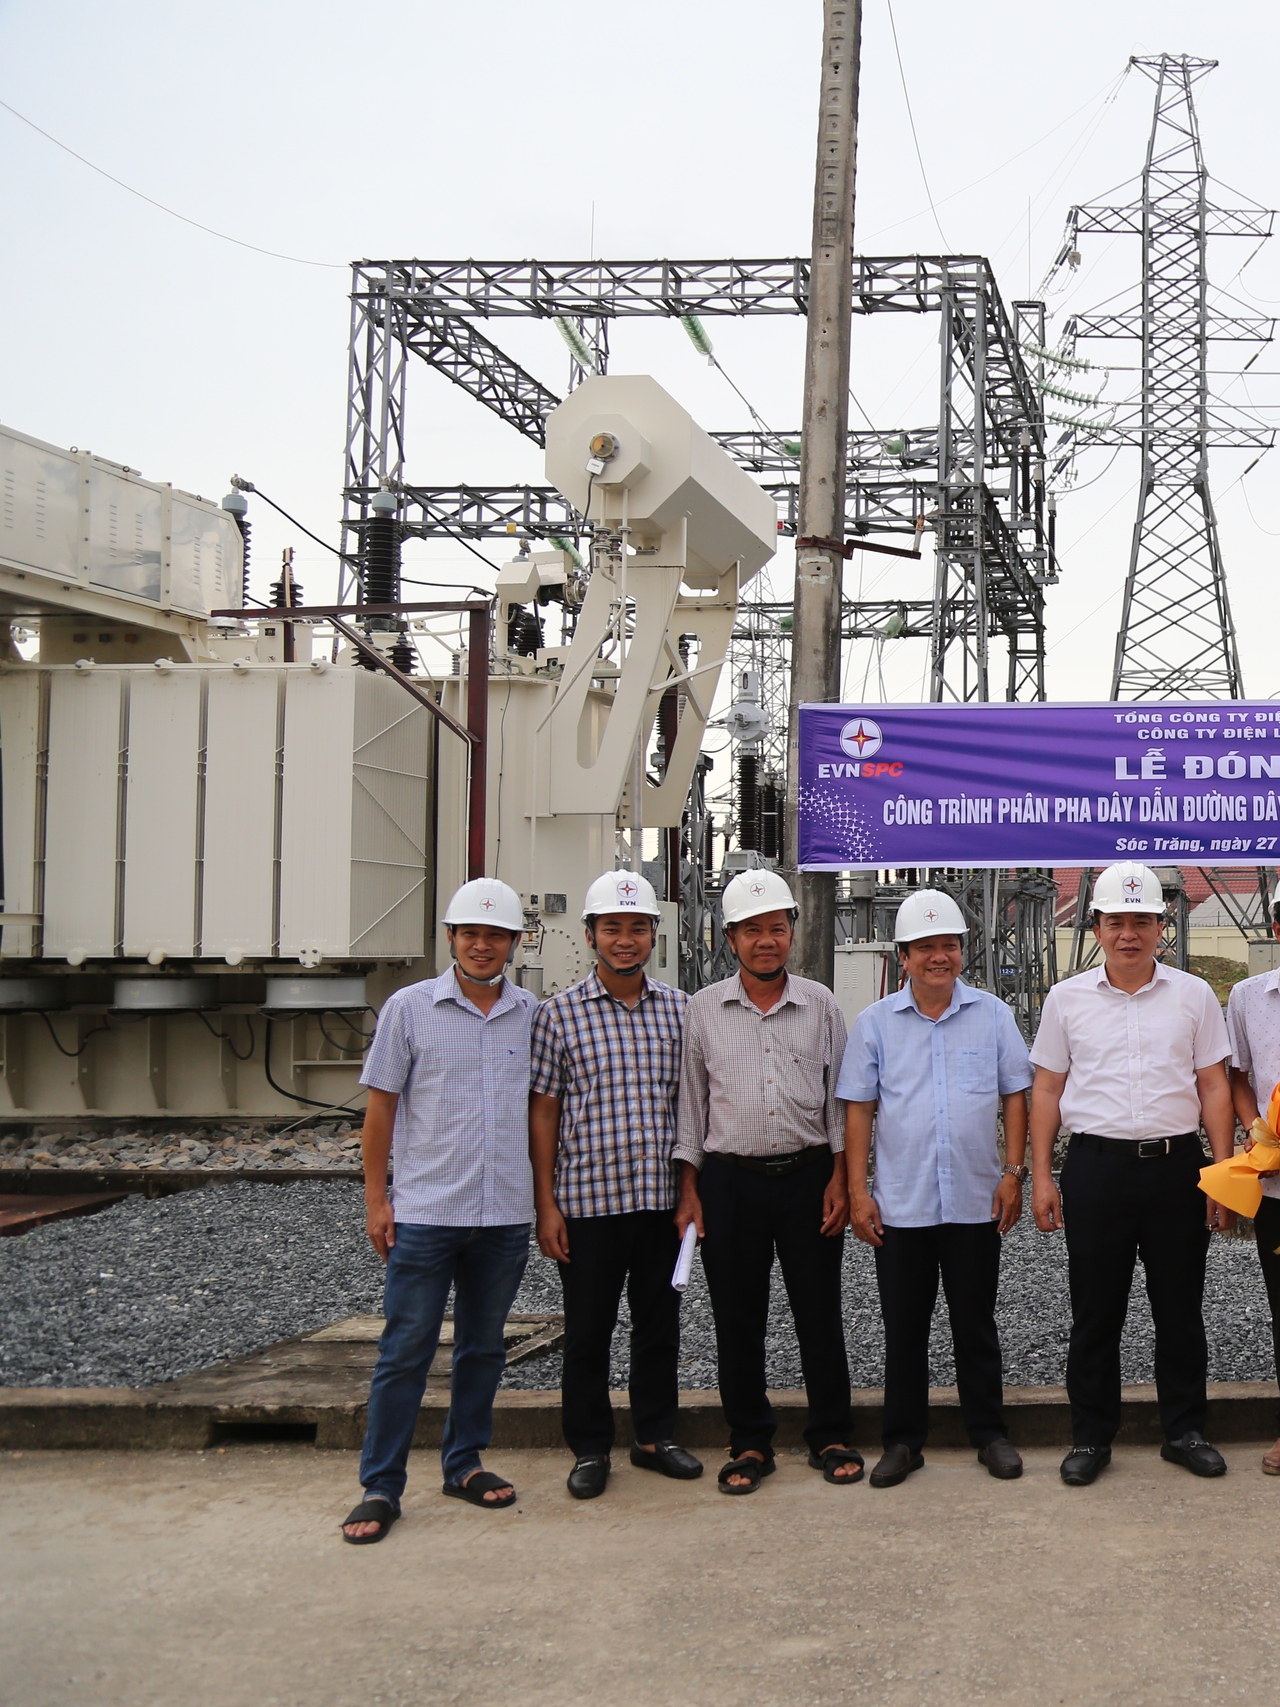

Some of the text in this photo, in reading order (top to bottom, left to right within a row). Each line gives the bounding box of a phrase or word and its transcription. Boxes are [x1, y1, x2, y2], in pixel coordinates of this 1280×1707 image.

[1113, 710, 1163, 724] TỔNG
[1169, 711, 1221, 723] CÔNG
[1227, 712, 1249, 723] TY
[1137, 726, 1189, 740] CÔNG
[1194, 728, 1218, 739] TY
[1223, 725, 1267, 741] ĐIỆN
[818, 762, 903, 779] EVNSPC
[1115, 747, 1167, 781] LỄ
[883, 794, 933, 826] CÔNG
[937, 792, 993, 825] TRÌNH
[998, 792, 1049, 824] PHÂN
[1054, 797, 1092, 823] PHA
[1097, 791, 1134, 823] DÂY
[1139, 786, 1178, 822] DẪN
[1182, 789, 1247, 822] ĐƯỜNG
[1115, 837, 1149, 851] Sóc
[1153, 837, 1205, 852] Trăng,
[1210, 836, 1251, 852] ngày
[1255, 836, 1278, 850] 27
